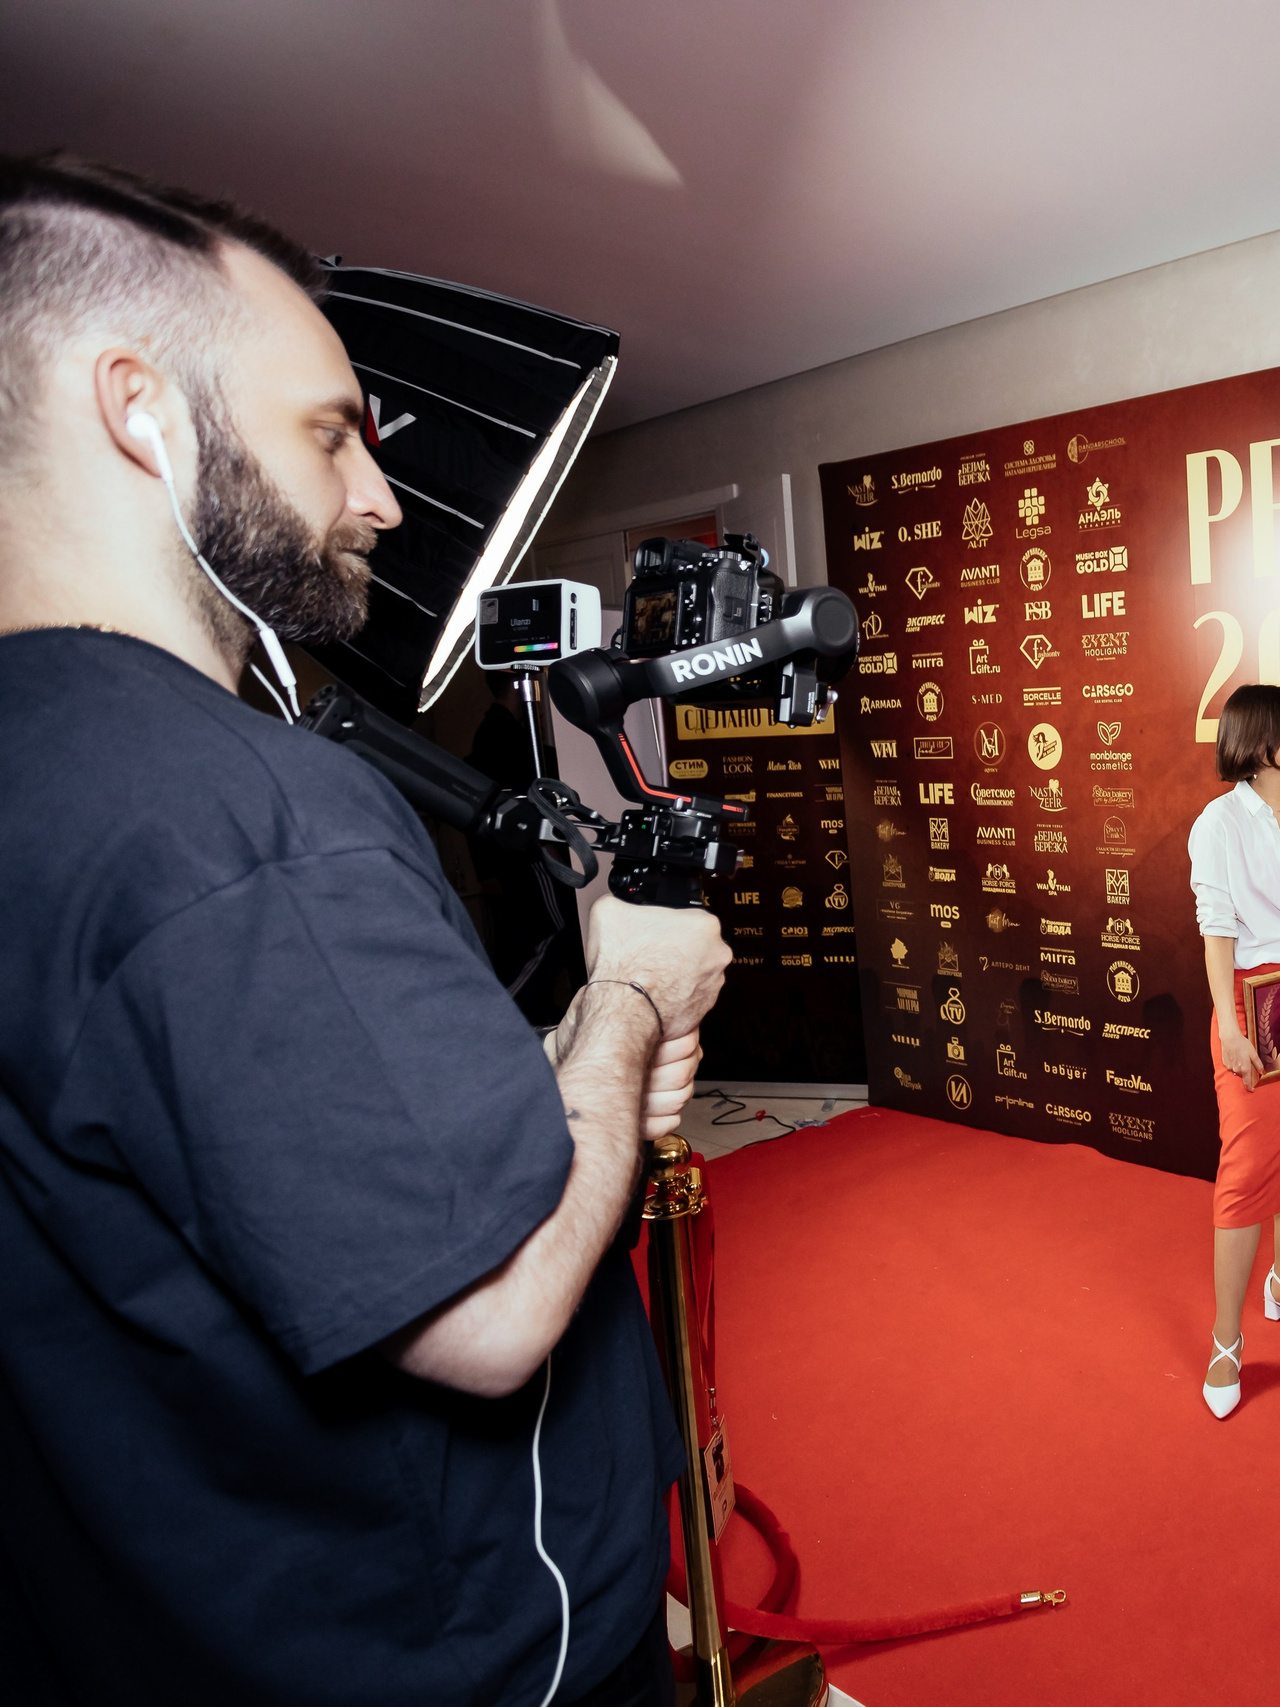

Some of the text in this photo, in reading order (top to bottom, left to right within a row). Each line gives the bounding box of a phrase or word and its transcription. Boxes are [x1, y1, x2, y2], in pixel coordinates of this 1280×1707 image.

[1078, 508, 1121, 525] АНАЭЛЬ
[914, 520, 942, 540] SHE
[1016, 526, 1052, 539] Legsa
[1075, 550, 1108, 561] MUSIC BOX
[1076, 559, 1109, 574] GOLD
[960, 565, 1000, 581] AVANTI
[1024, 601, 1052, 621] FSB
[1081, 591, 1126, 619] LIFE
[906, 613, 946, 627] ЭКСПРЕСС
[1081, 631, 1130, 649] EVENT
[1085, 646, 1127, 657] HOOLIGANS
[671, 638, 763, 683] RONIN
[976, 653, 988, 664] Art
[859, 662, 883, 674] GOLD
[976, 664, 1000, 675] Gift.ru
[1023, 692, 1061, 701] BORCELLE
[870, 698, 902, 710] ARMADA
[675, 761, 704, 770] СТИМ
[722, 755, 753, 764] FASHION
[723, 763, 753, 774] LOOK
[1091, 762, 1133, 771] cosmetics
[918, 782, 954, 805] LIFE
[970, 782, 1015, 801] Советское
[821, 819, 844, 829] mos
[977, 827, 1015, 840] AVANTI
[1038, 830, 1062, 842] БЕЛАЯ
[934, 872, 956, 882] ВОДА
[1056, 884, 1071, 892] THAI
[734, 892, 760, 904] LIFE
[1106, 895, 1130, 905] BAKERY
[930, 903, 960, 919] mos
[1047, 925, 1072, 935] ВОДА
[1101, 934, 1140, 945] HORSE FORCE
[1103, 1023, 1151, 1039] ЭКСПРЕСС
[1003, 1057, 1016, 1068] Art
[1003, 1067, 1028, 1080] Gift.ru
[1044, 1061, 1087, 1080] babyer
[1108, 1112, 1155, 1133] EVENT
[1112, 1125, 1153, 1140] HOOLIGANS
